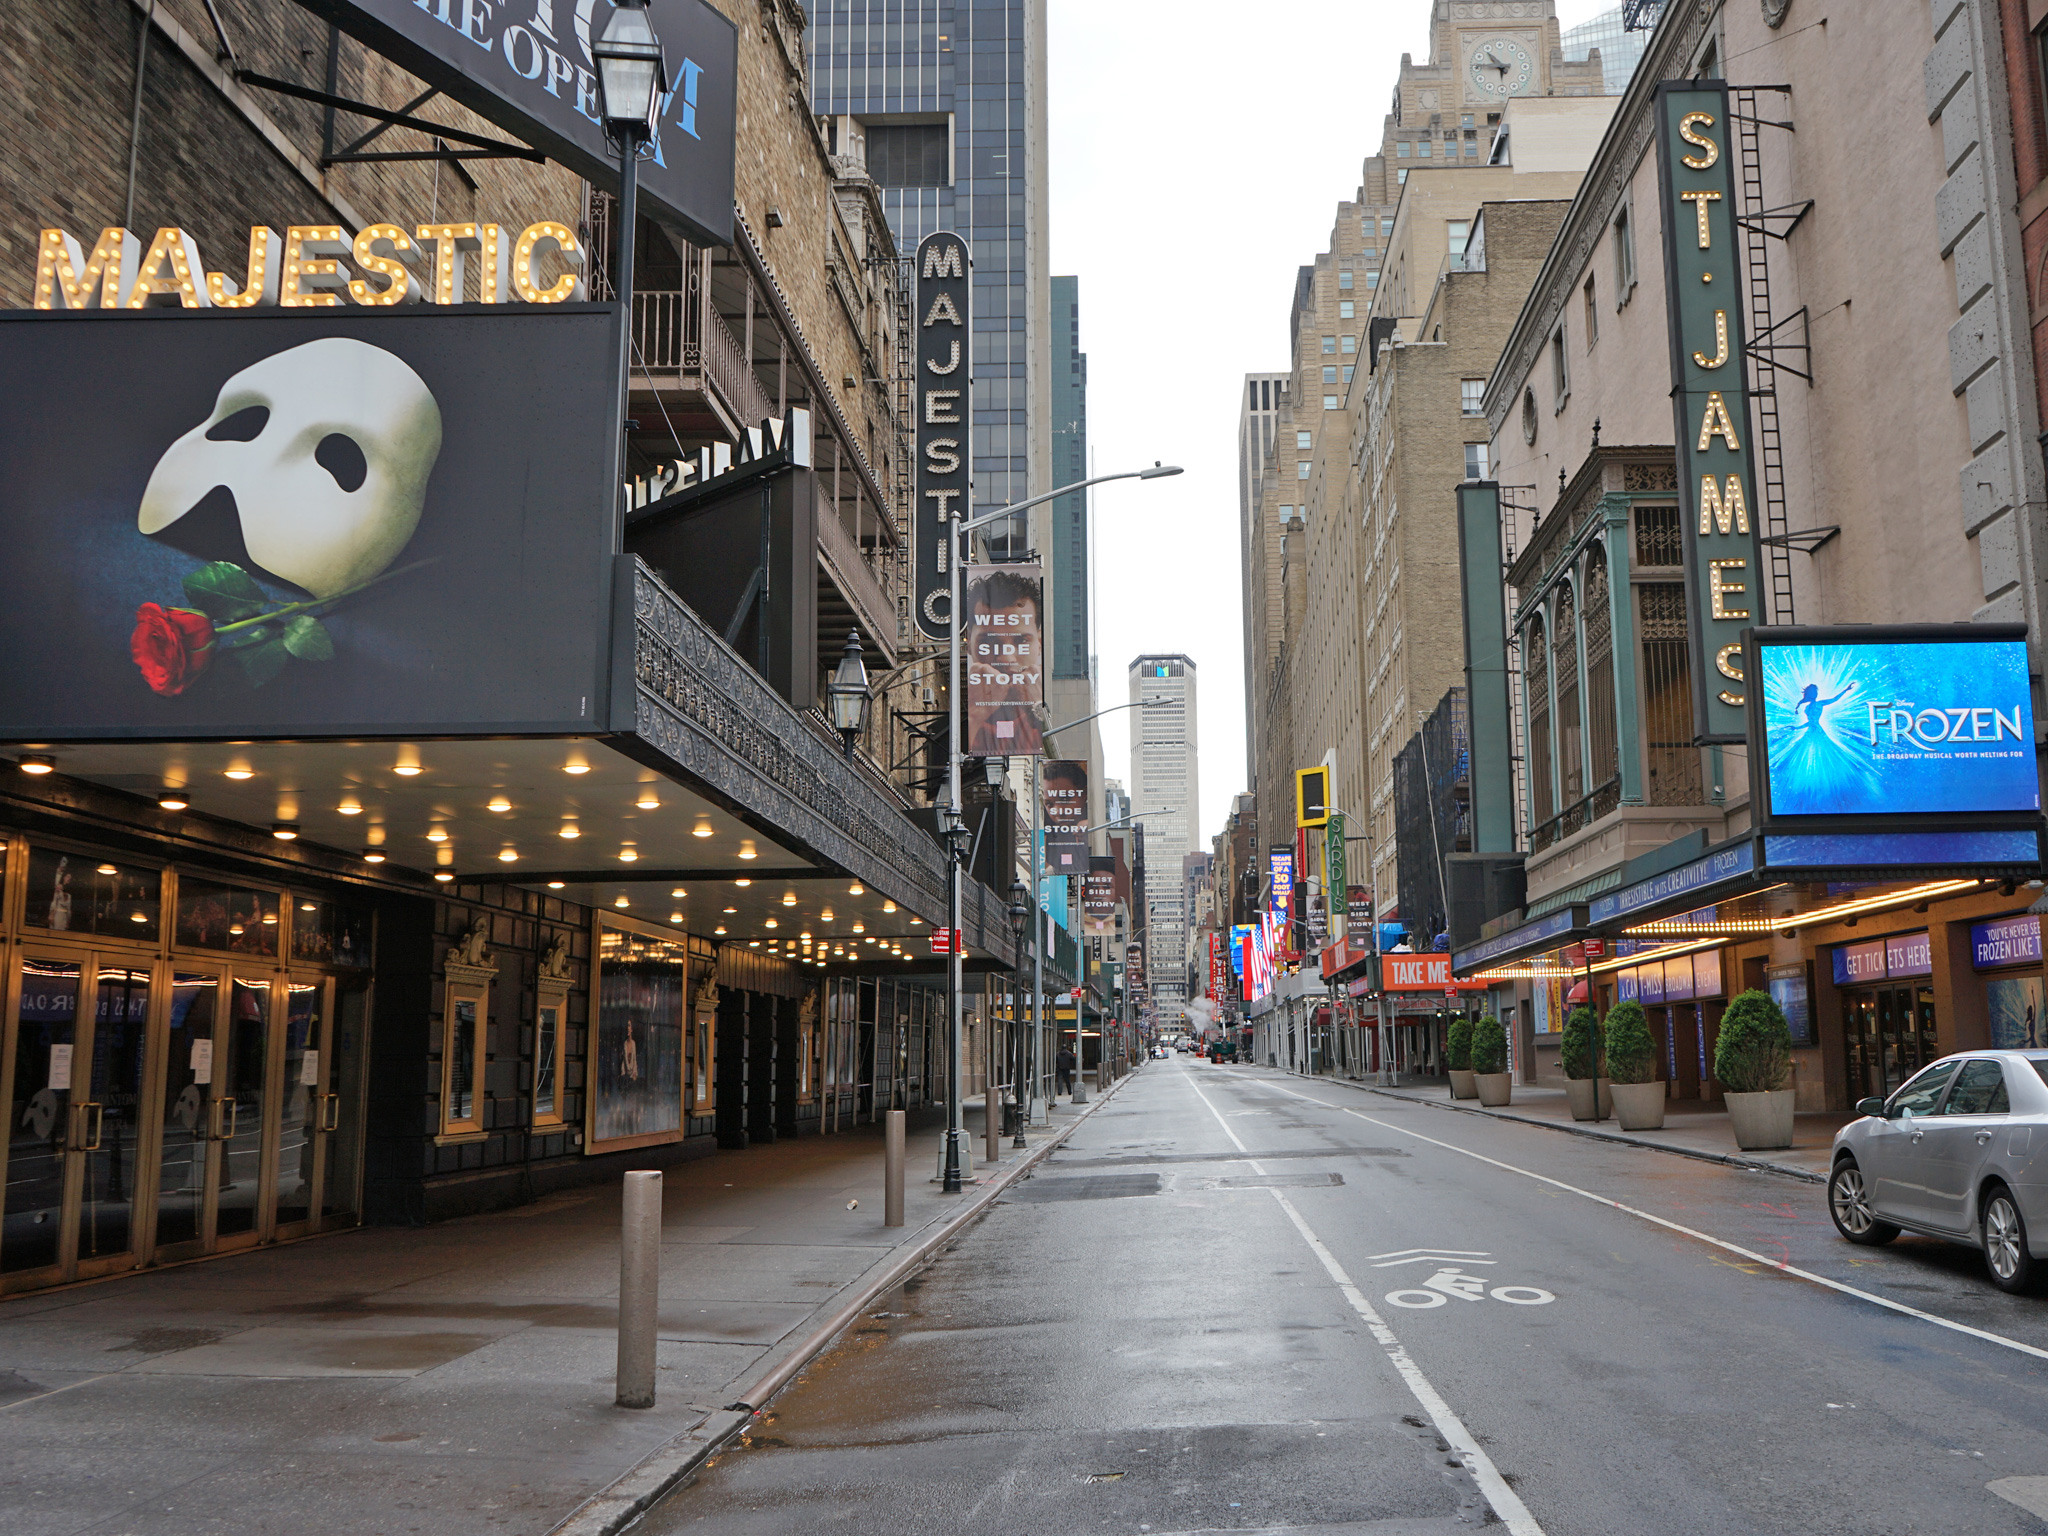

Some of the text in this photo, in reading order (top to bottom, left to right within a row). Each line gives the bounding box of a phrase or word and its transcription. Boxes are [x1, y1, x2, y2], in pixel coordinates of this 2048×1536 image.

[34, 221, 586, 309] MAJESTIC
[922, 244, 963, 625] MAJESTIC
[974, 614, 1033, 626] WEST
[978, 643, 1030, 655] SIDE
[969, 673, 1040, 685] STORY
[1866, 701, 2023, 751] FROZEN
[1047, 789, 1084, 797] WEST
[1049, 807, 1082, 815] SIDE
[1044, 825, 1088, 833] STORY
[1273, 873, 1289, 884] 50
[2009, 923, 2029, 938] NEVER
[1978, 940, 2012, 962] FROZEN
[2013, 936, 2034, 957] LIKE
[1846, 943, 1932, 975] GET TICKETS HERE
[1391, 960, 1450, 984] TAKE ME
